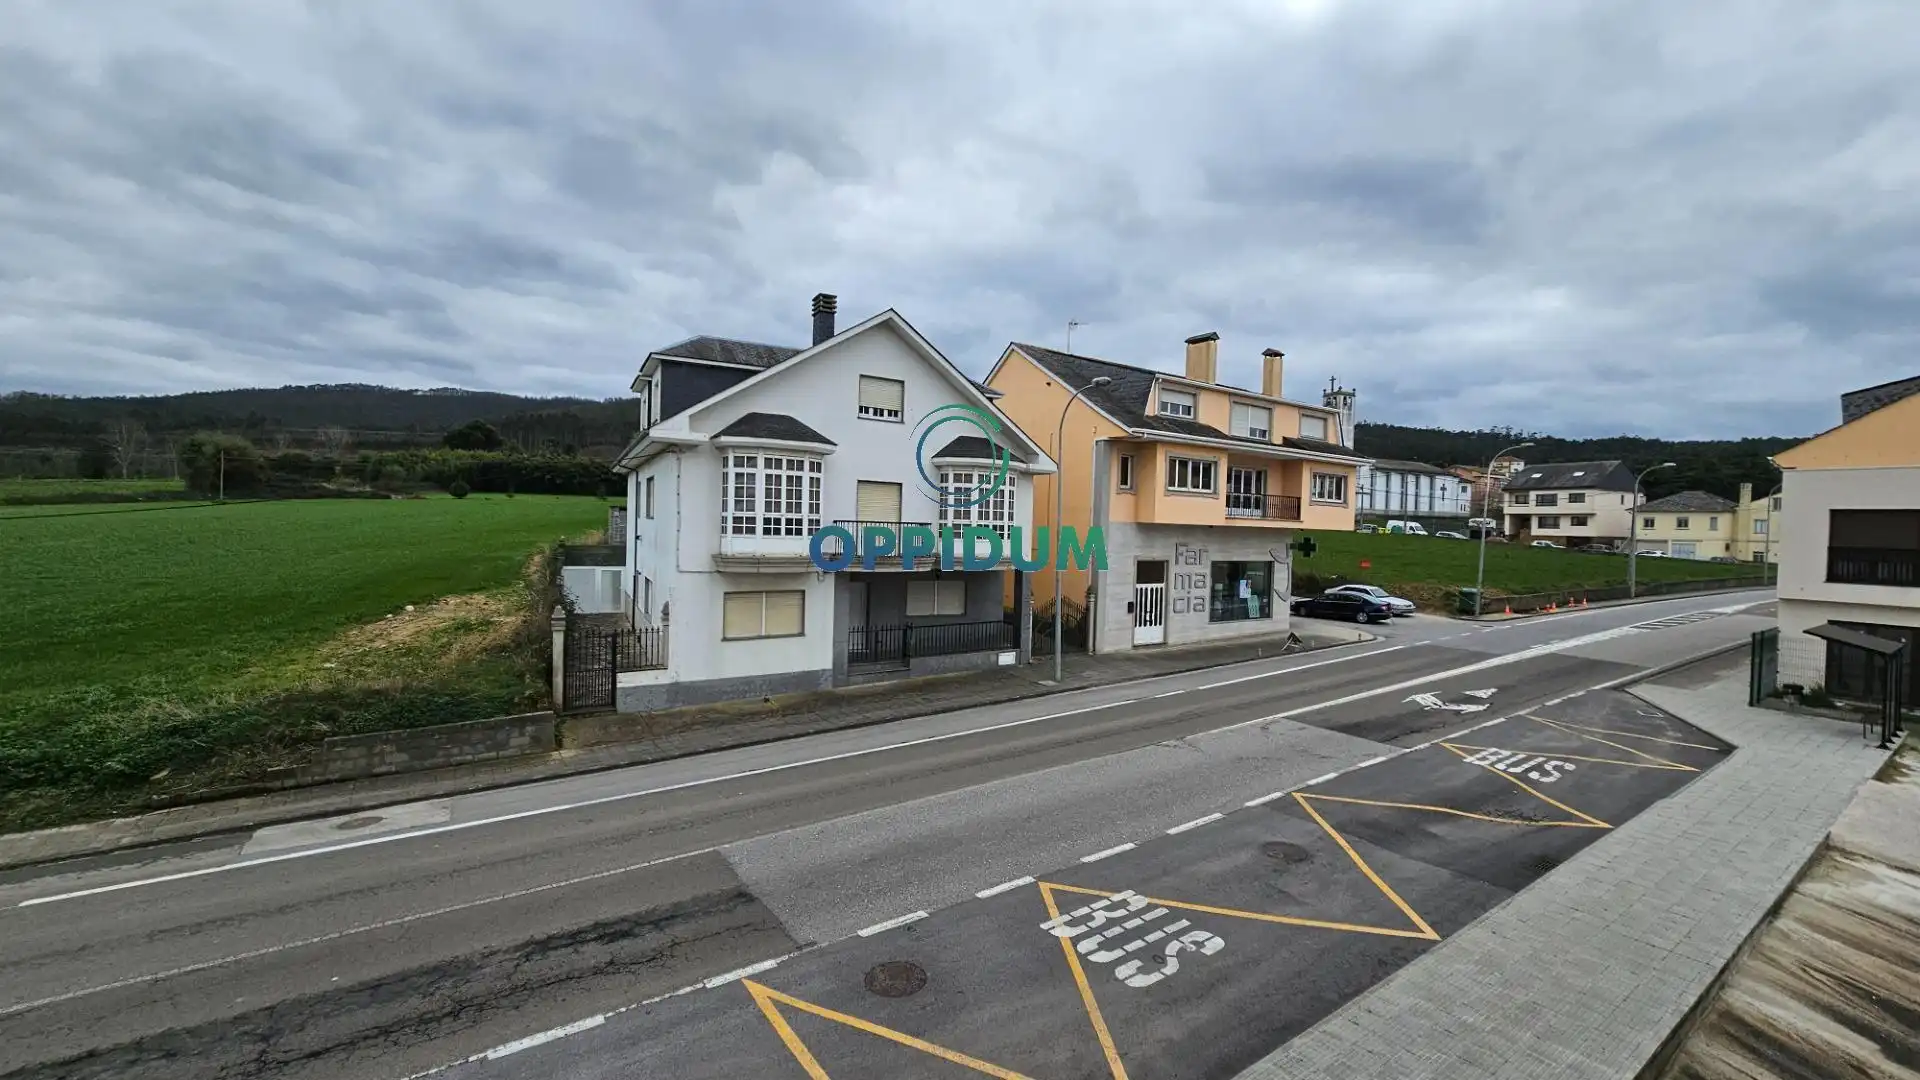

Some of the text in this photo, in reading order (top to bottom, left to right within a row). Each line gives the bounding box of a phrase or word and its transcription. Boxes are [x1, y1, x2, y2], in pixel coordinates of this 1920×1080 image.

[1175, 542, 1209, 566] Far
[1174, 572, 1207, 590] ma
[1173, 591, 1206, 613] cia
[1463, 748, 1576, 783] BUS
[1039, 889, 1226, 987] BUS
